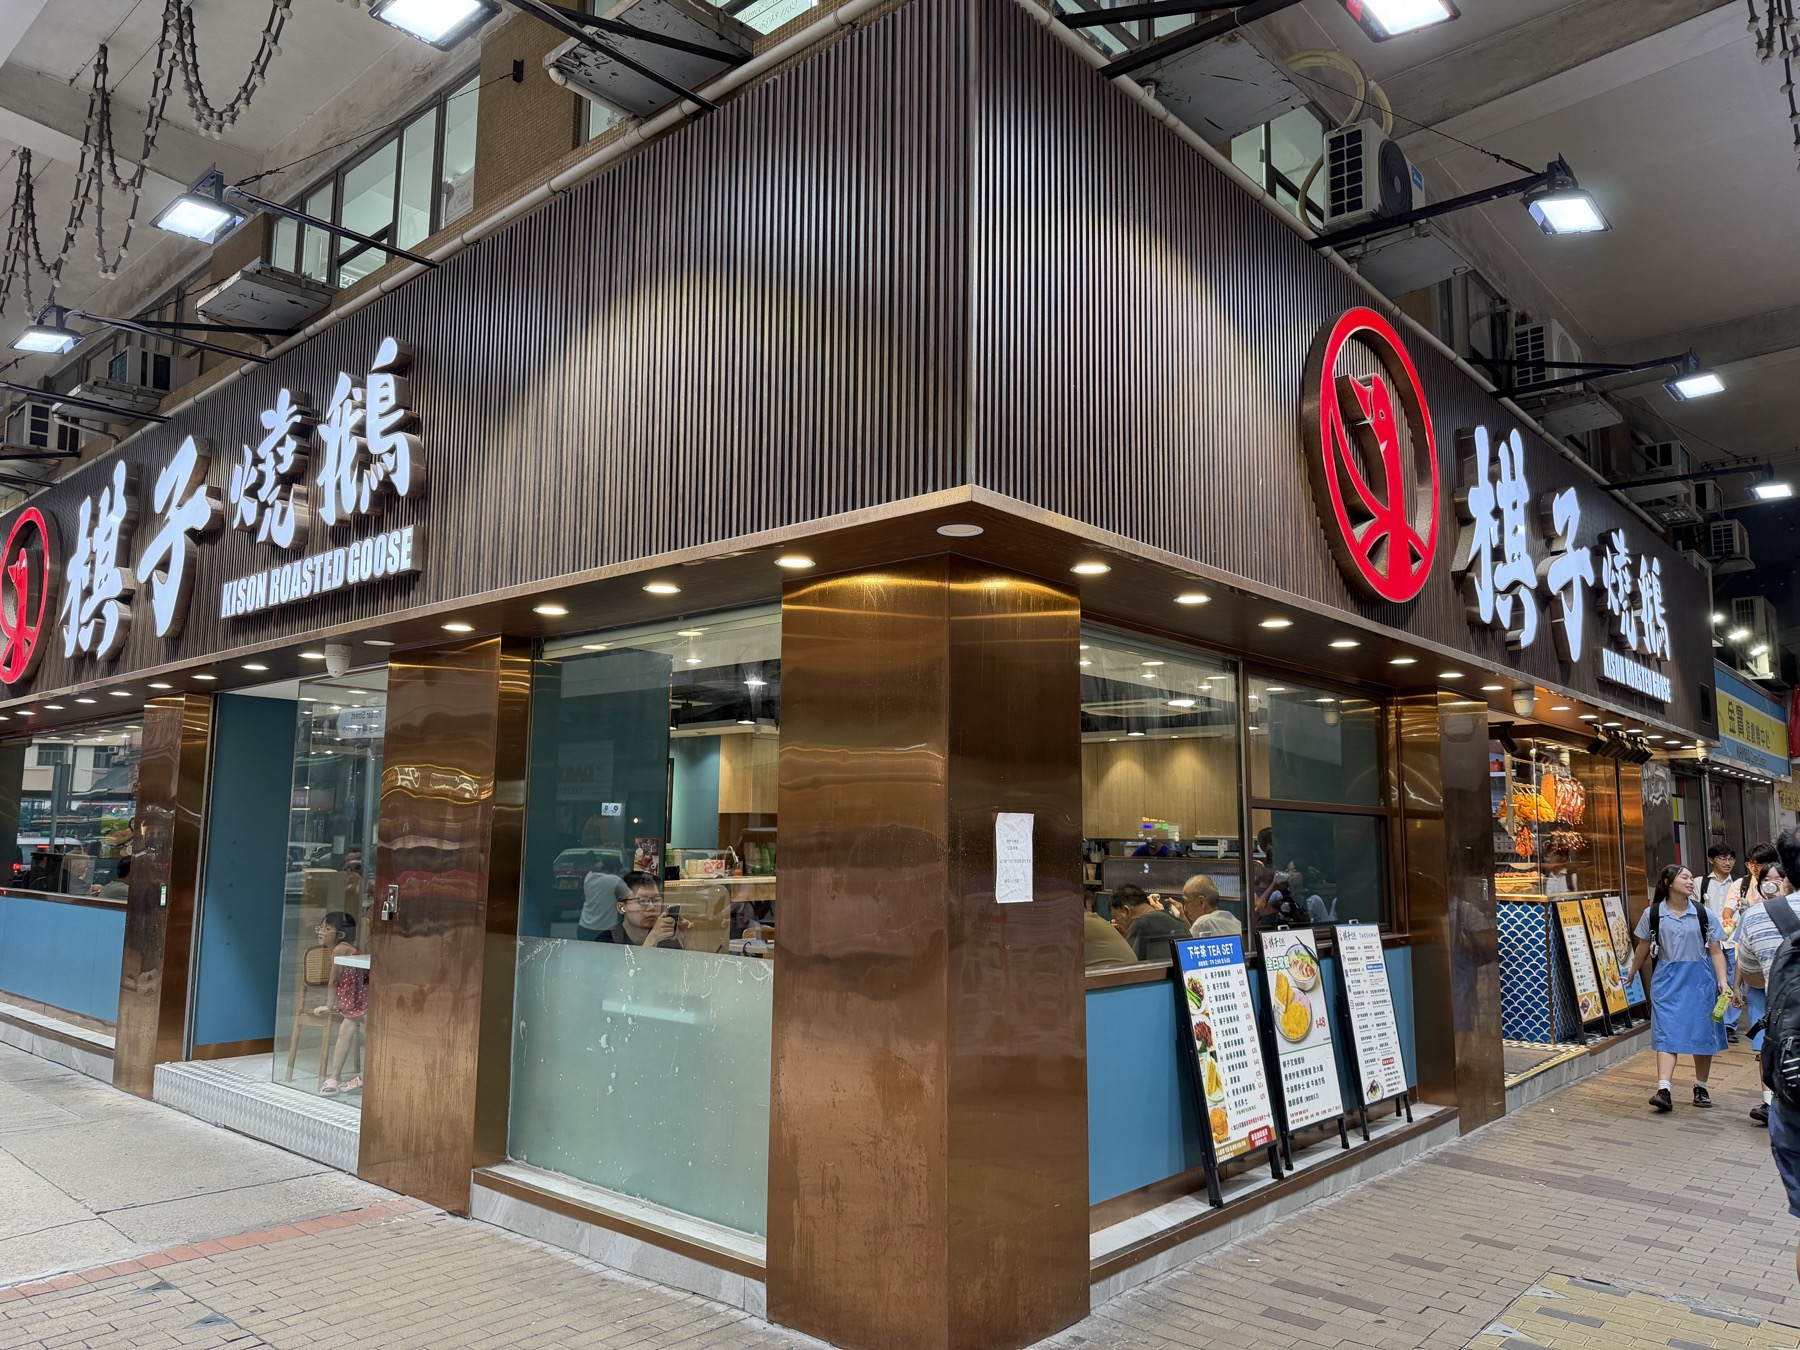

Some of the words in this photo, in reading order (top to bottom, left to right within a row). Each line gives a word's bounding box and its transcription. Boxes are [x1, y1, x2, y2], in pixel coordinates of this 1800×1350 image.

[60, 337, 411, 660] 棋子燒鵝
[221, 571, 268, 619] KISON
[269, 548, 346, 607] ROASTED
[348, 527, 414, 585] GOOSE
[1603, 648, 1626, 686] KISON
[1625, 657, 1653, 696] ROASTED
[1652, 670, 1672, 704] GOOSE
[1187, 944, 1207, 960] 下午茶
[1207, 945, 1221, 957] TEA
[1221, 943, 1234, 955] SET
[1316, 1016, 1326, 1028] $48
